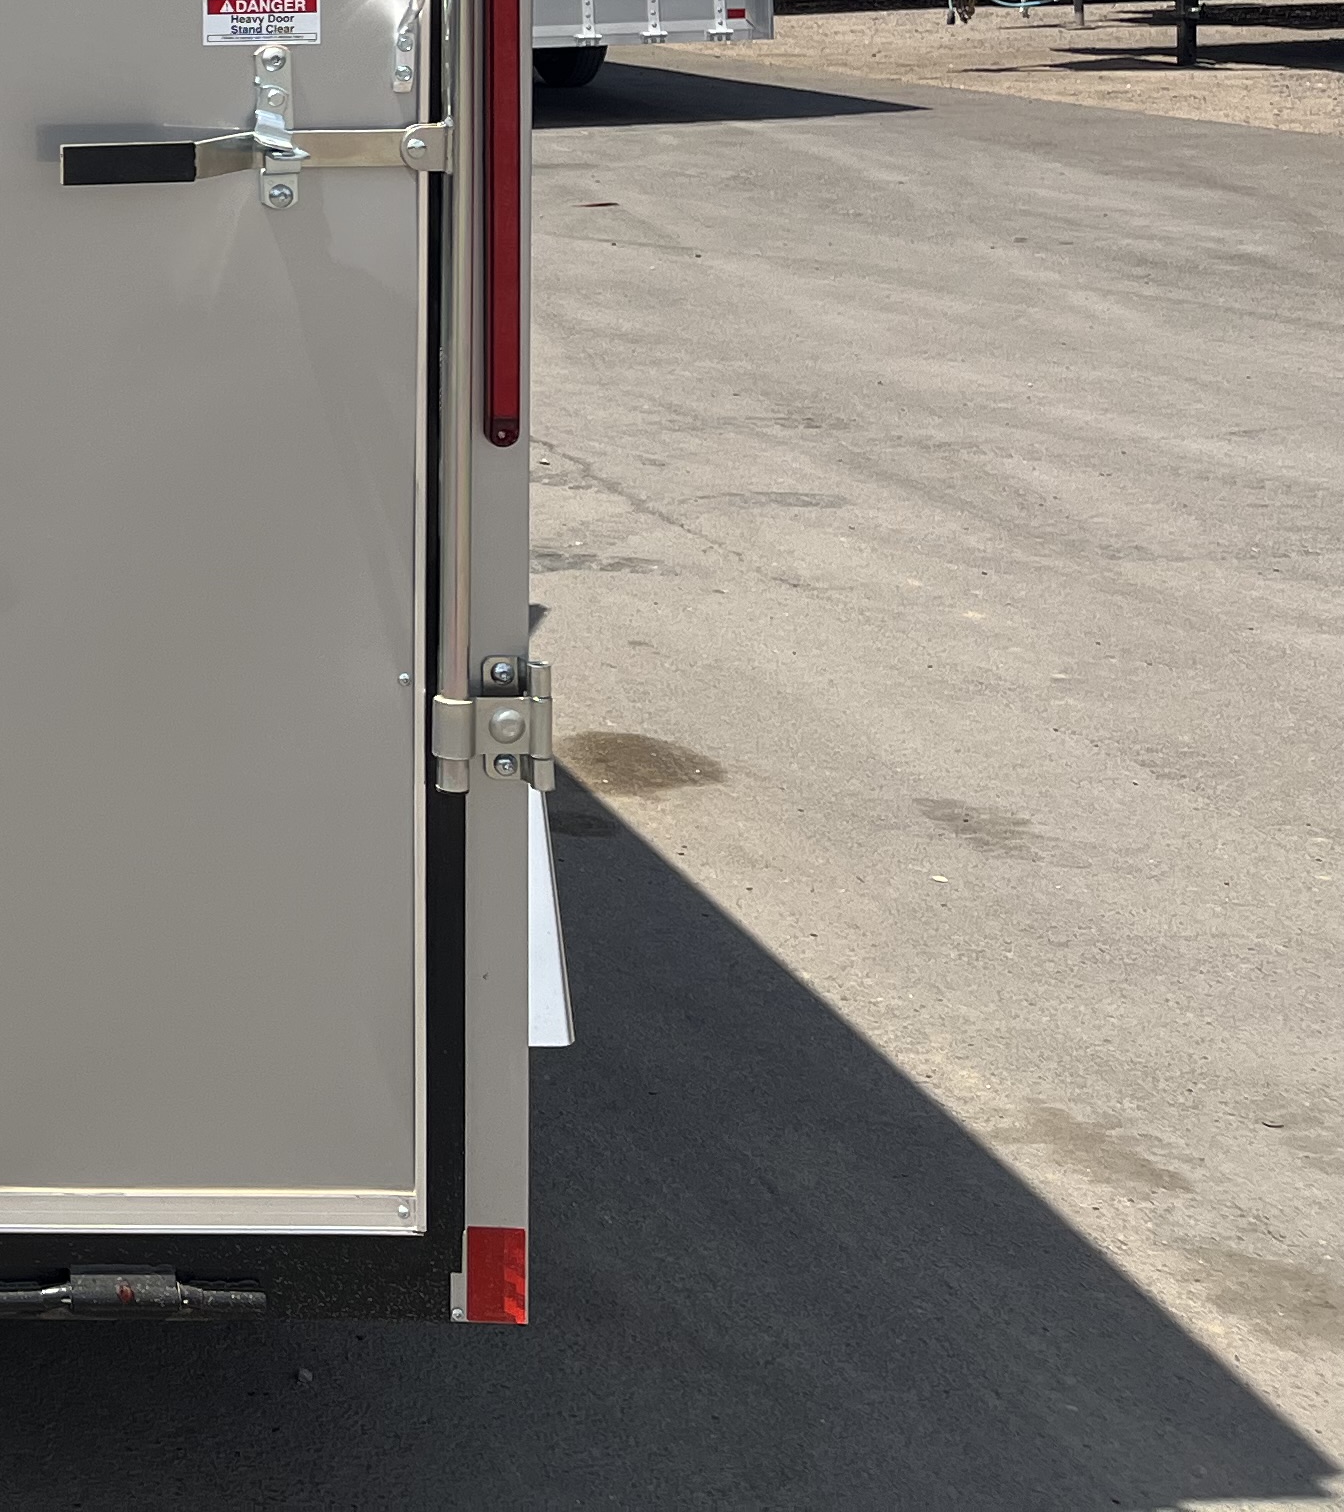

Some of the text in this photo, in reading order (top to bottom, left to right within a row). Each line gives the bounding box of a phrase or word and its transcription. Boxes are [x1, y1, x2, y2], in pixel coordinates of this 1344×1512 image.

[231, 14, 295, 27] Heavy Door
[231, 24, 295, 35] Stand Clear
